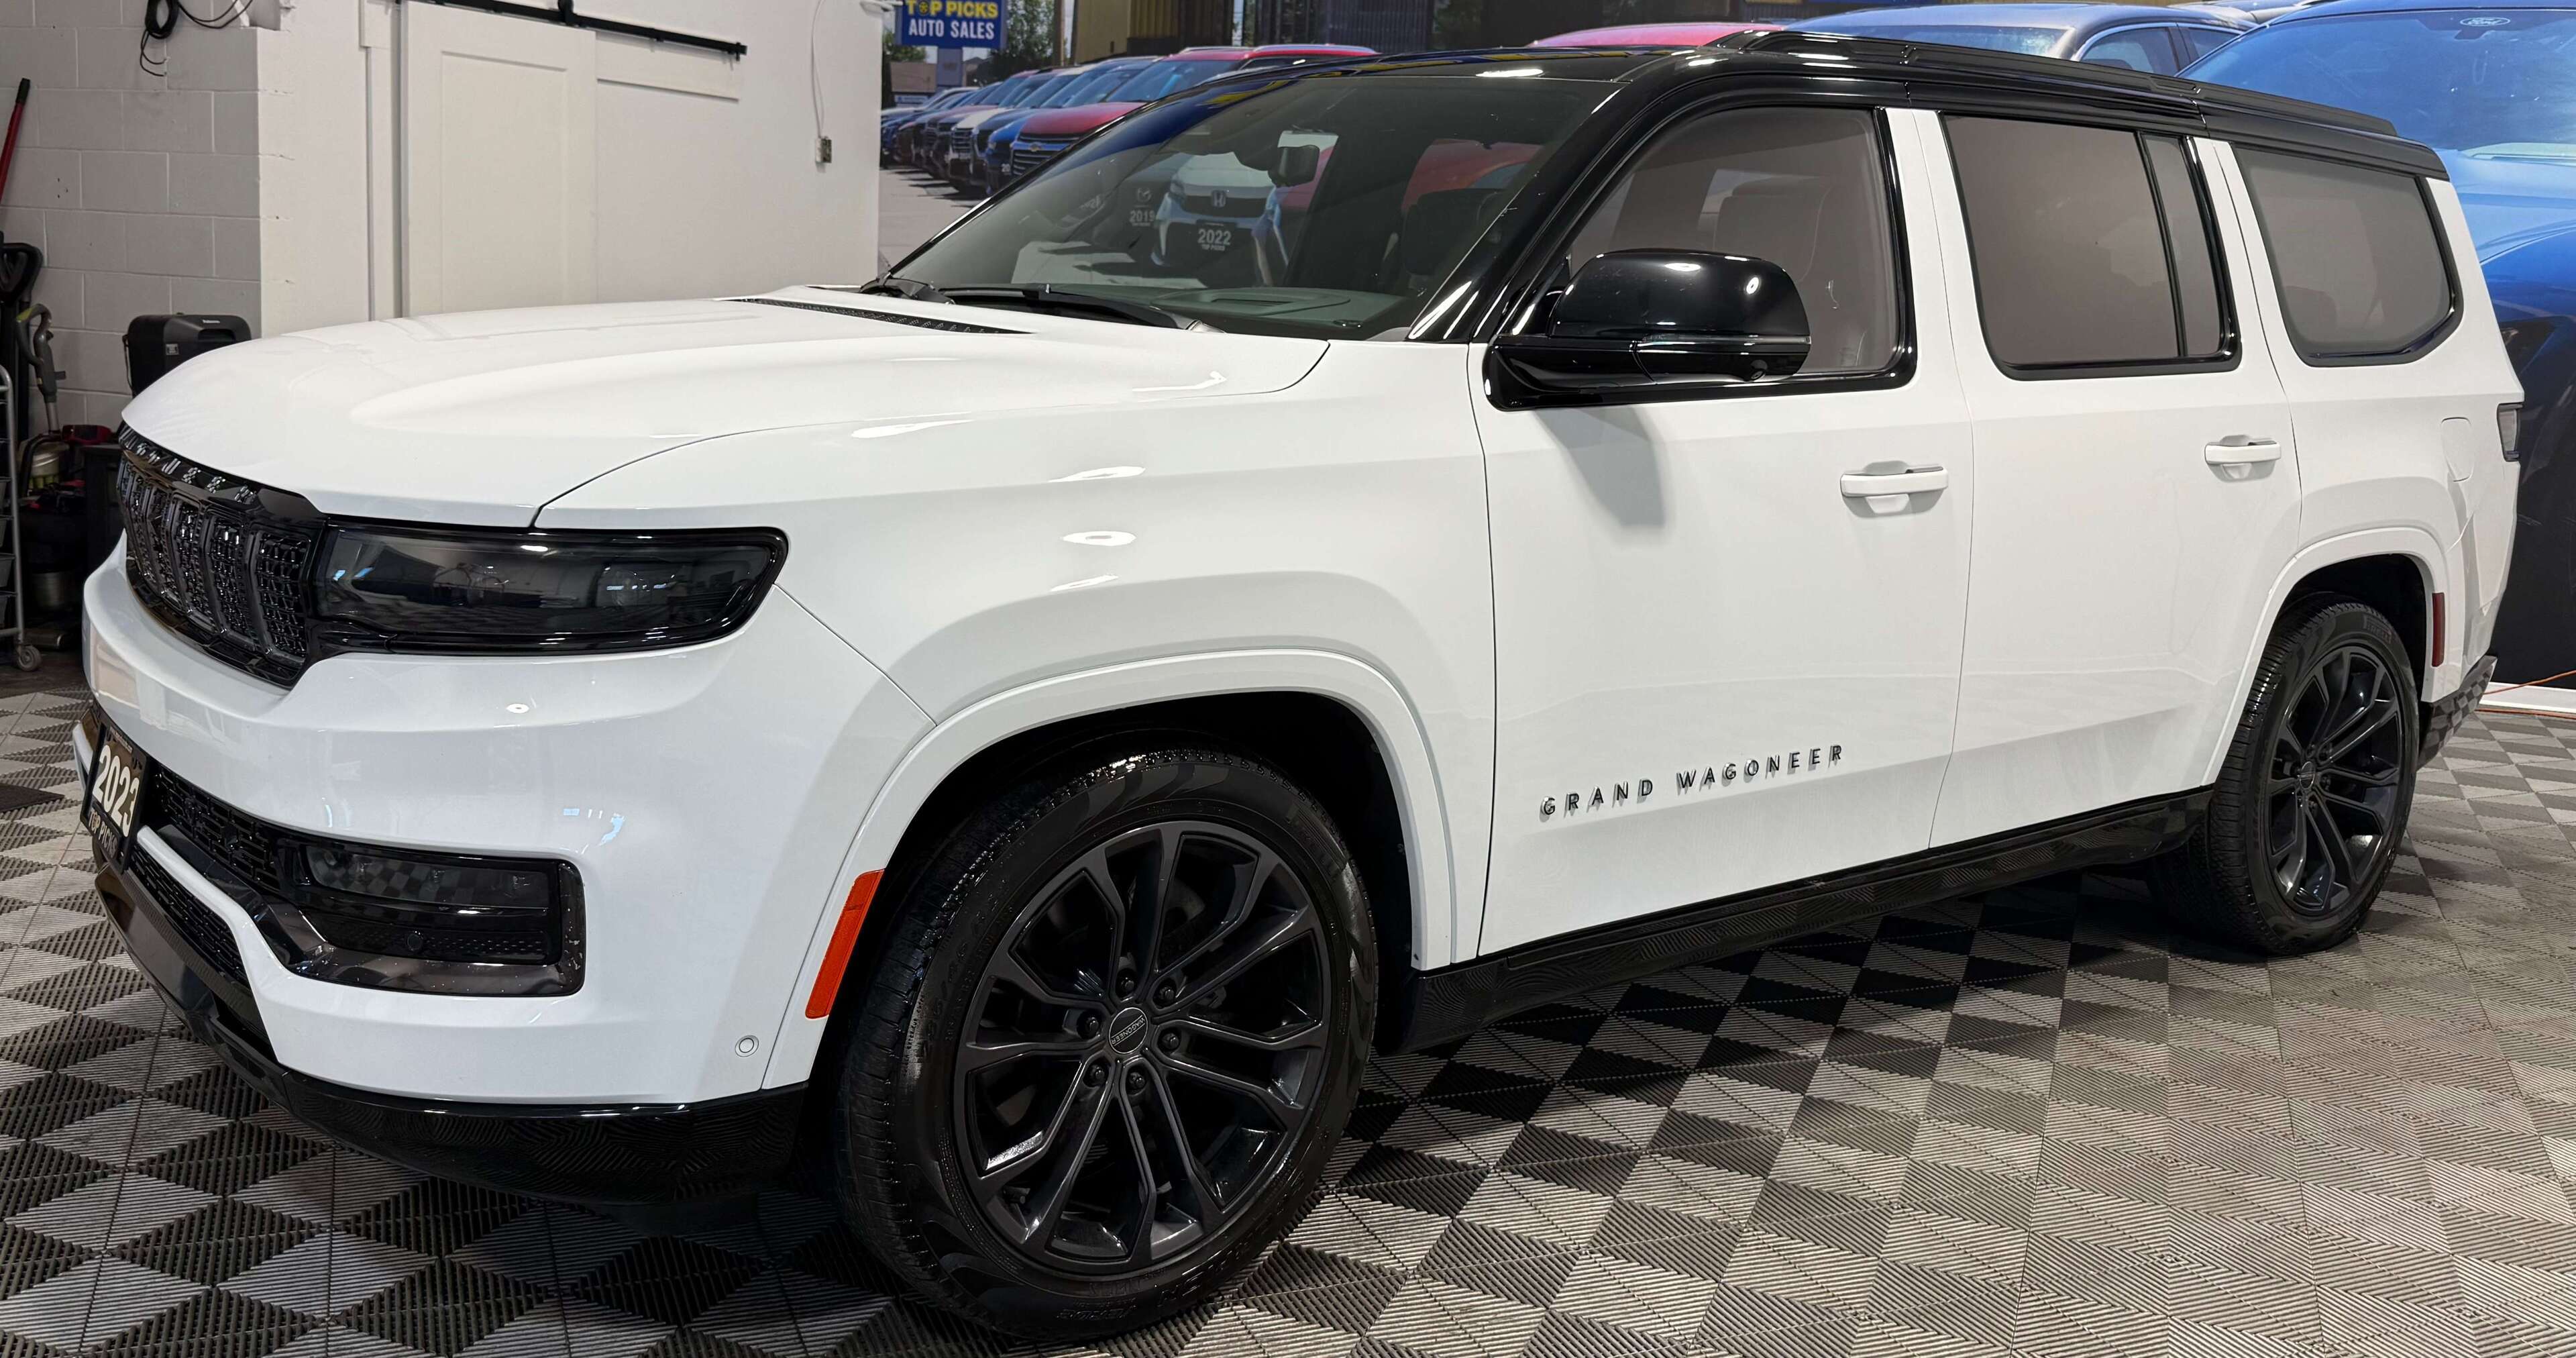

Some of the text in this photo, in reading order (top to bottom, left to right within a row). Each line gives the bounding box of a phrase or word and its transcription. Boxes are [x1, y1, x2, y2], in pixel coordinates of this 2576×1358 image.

[946, 1, 998, 19] PICKS
[909, 19, 994, 40] AUTO SALES
[1197, 229, 1232, 246] 2022
[92, 744, 140, 837] 2023
[1542, 744, 1842, 817] GRAND WAGONEER
[89, 807, 118, 859] TOP PICKS
[1111, 1017, 1146, 1045] WAGONEER
